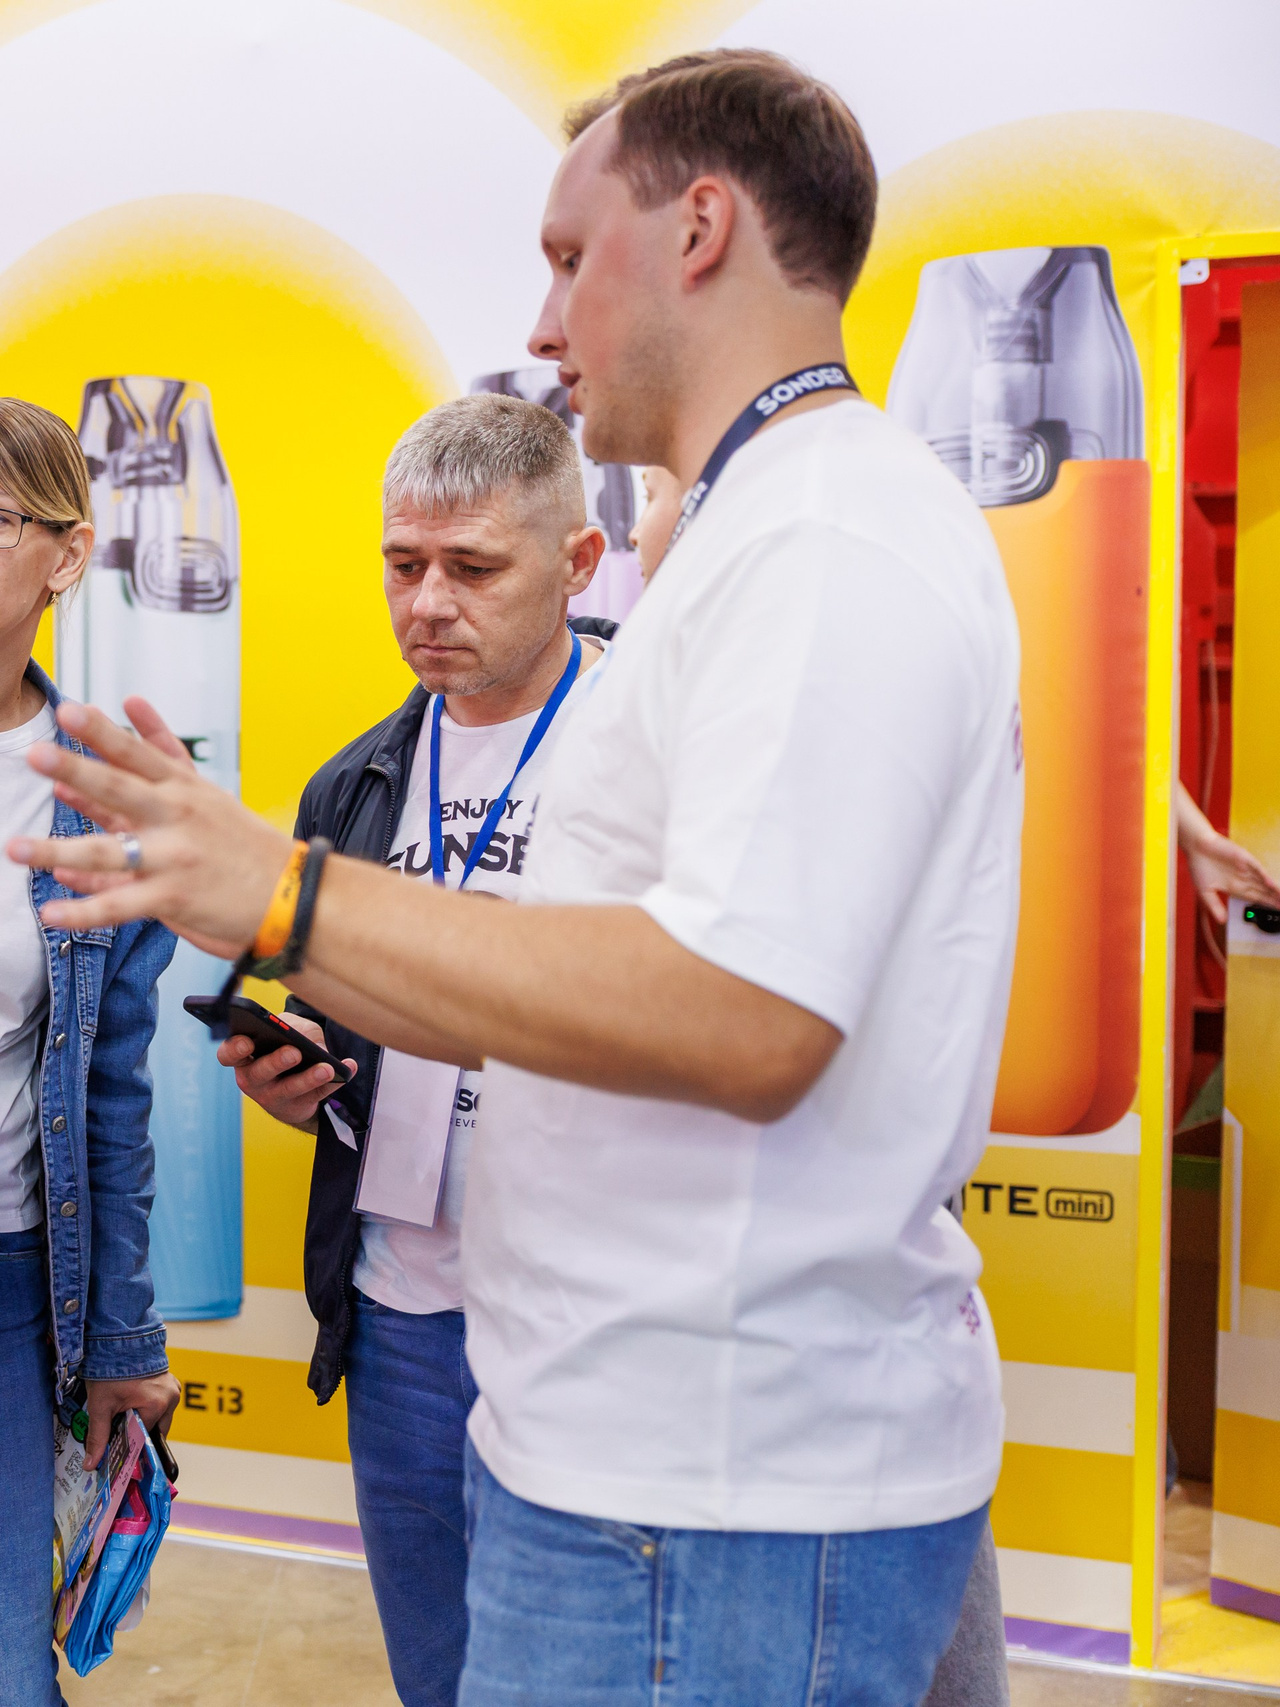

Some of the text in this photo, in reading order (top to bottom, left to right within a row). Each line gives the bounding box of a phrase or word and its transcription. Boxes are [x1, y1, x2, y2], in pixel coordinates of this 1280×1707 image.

[755, 367, 850, 417] SONDER
[1054, 1193, 1105, 1216] mini
[217, 1385, 244, 1415] i3
